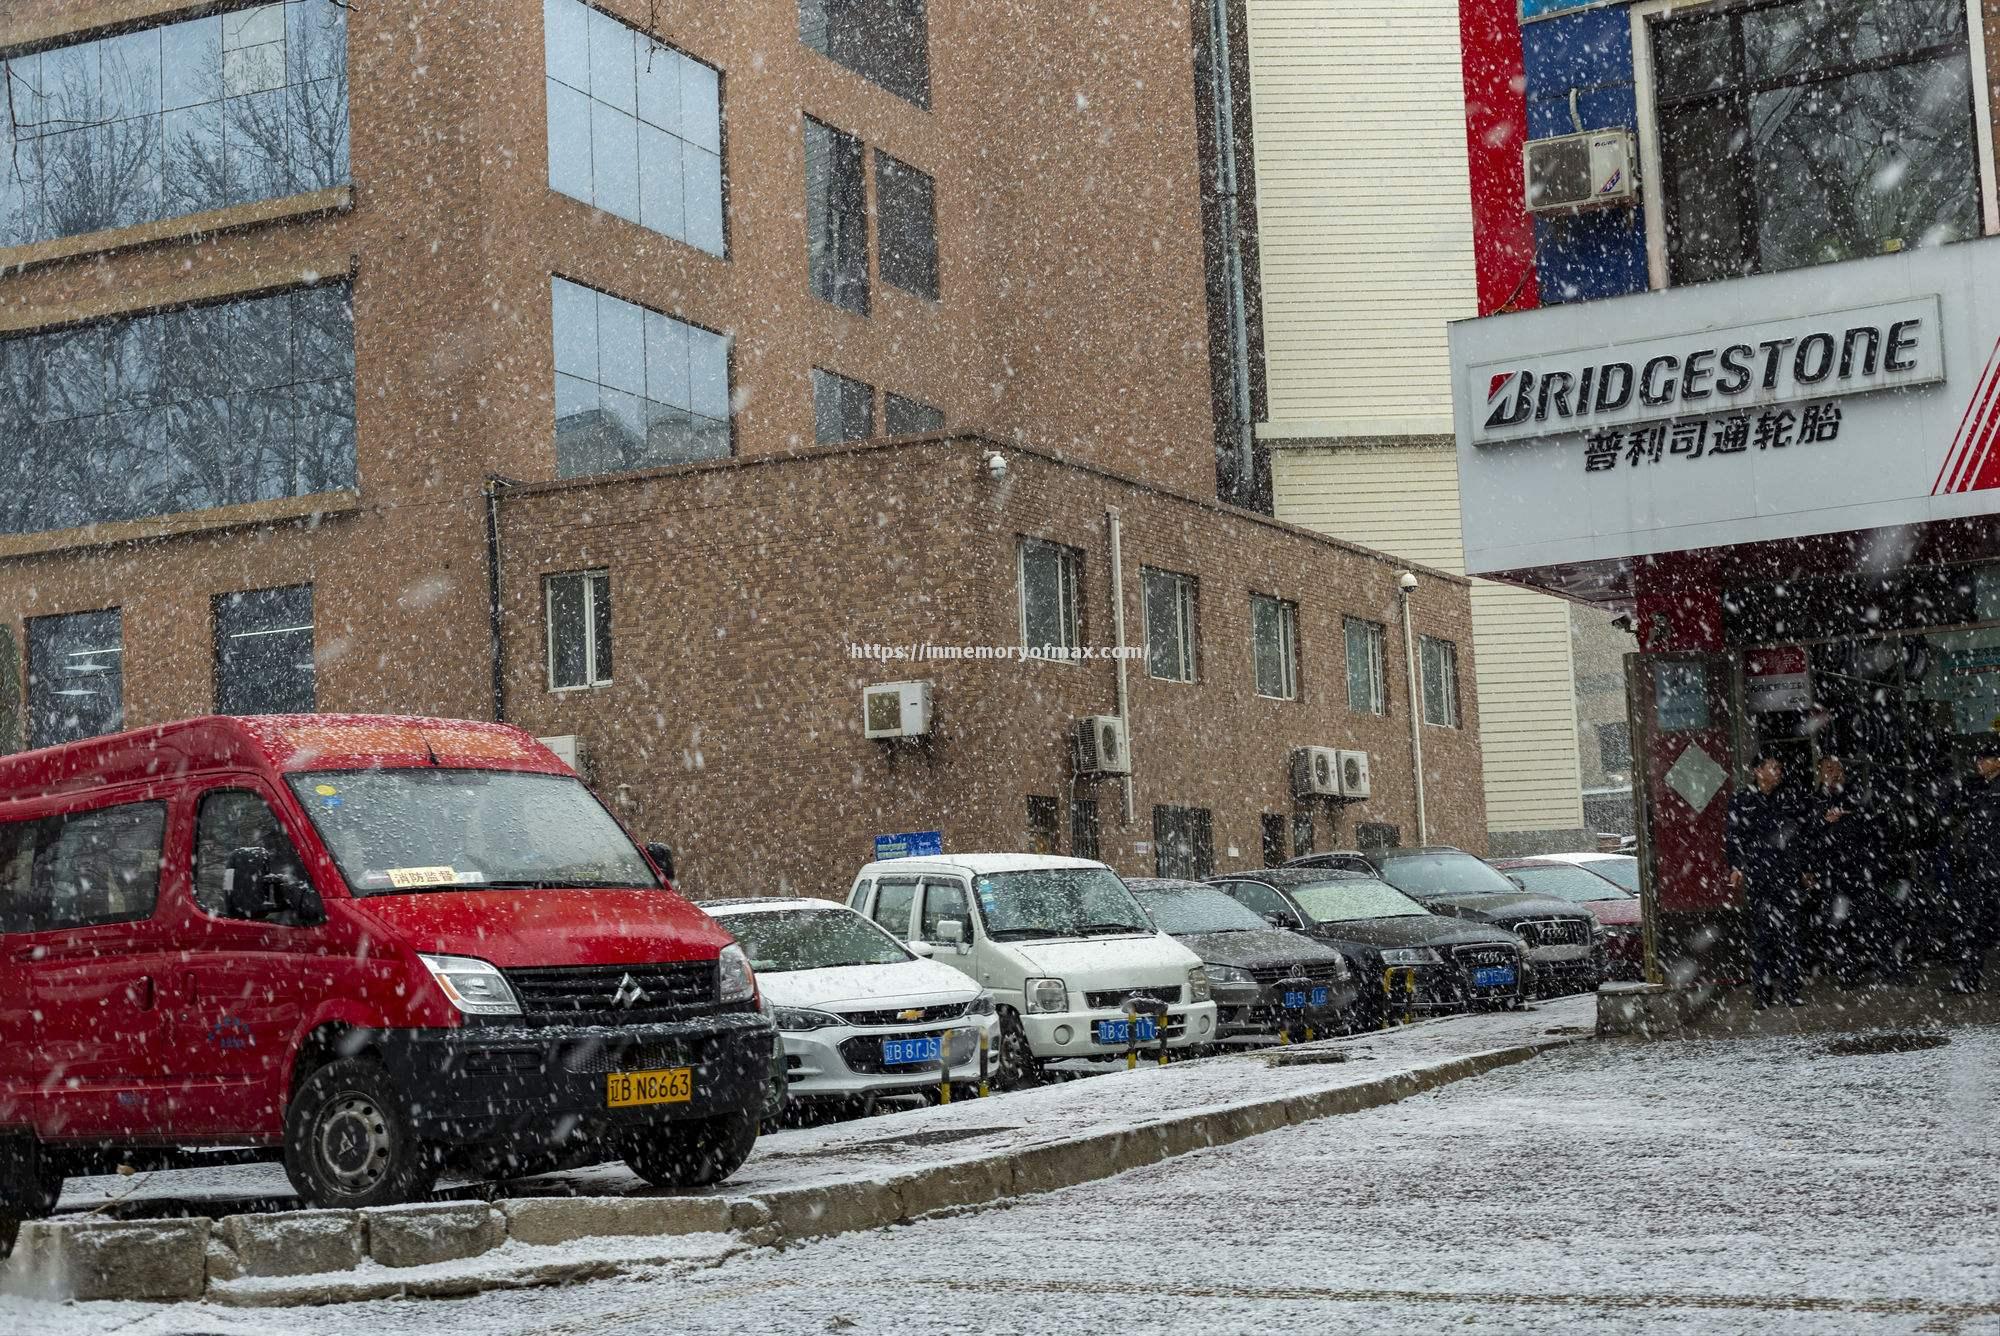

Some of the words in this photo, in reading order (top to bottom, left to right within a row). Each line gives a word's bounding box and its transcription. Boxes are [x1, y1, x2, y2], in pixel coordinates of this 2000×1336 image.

[1484, 318, 1922, 429] BRIDGESTONE
[1584, 402, 1843, 473] 普利司通轮胎
